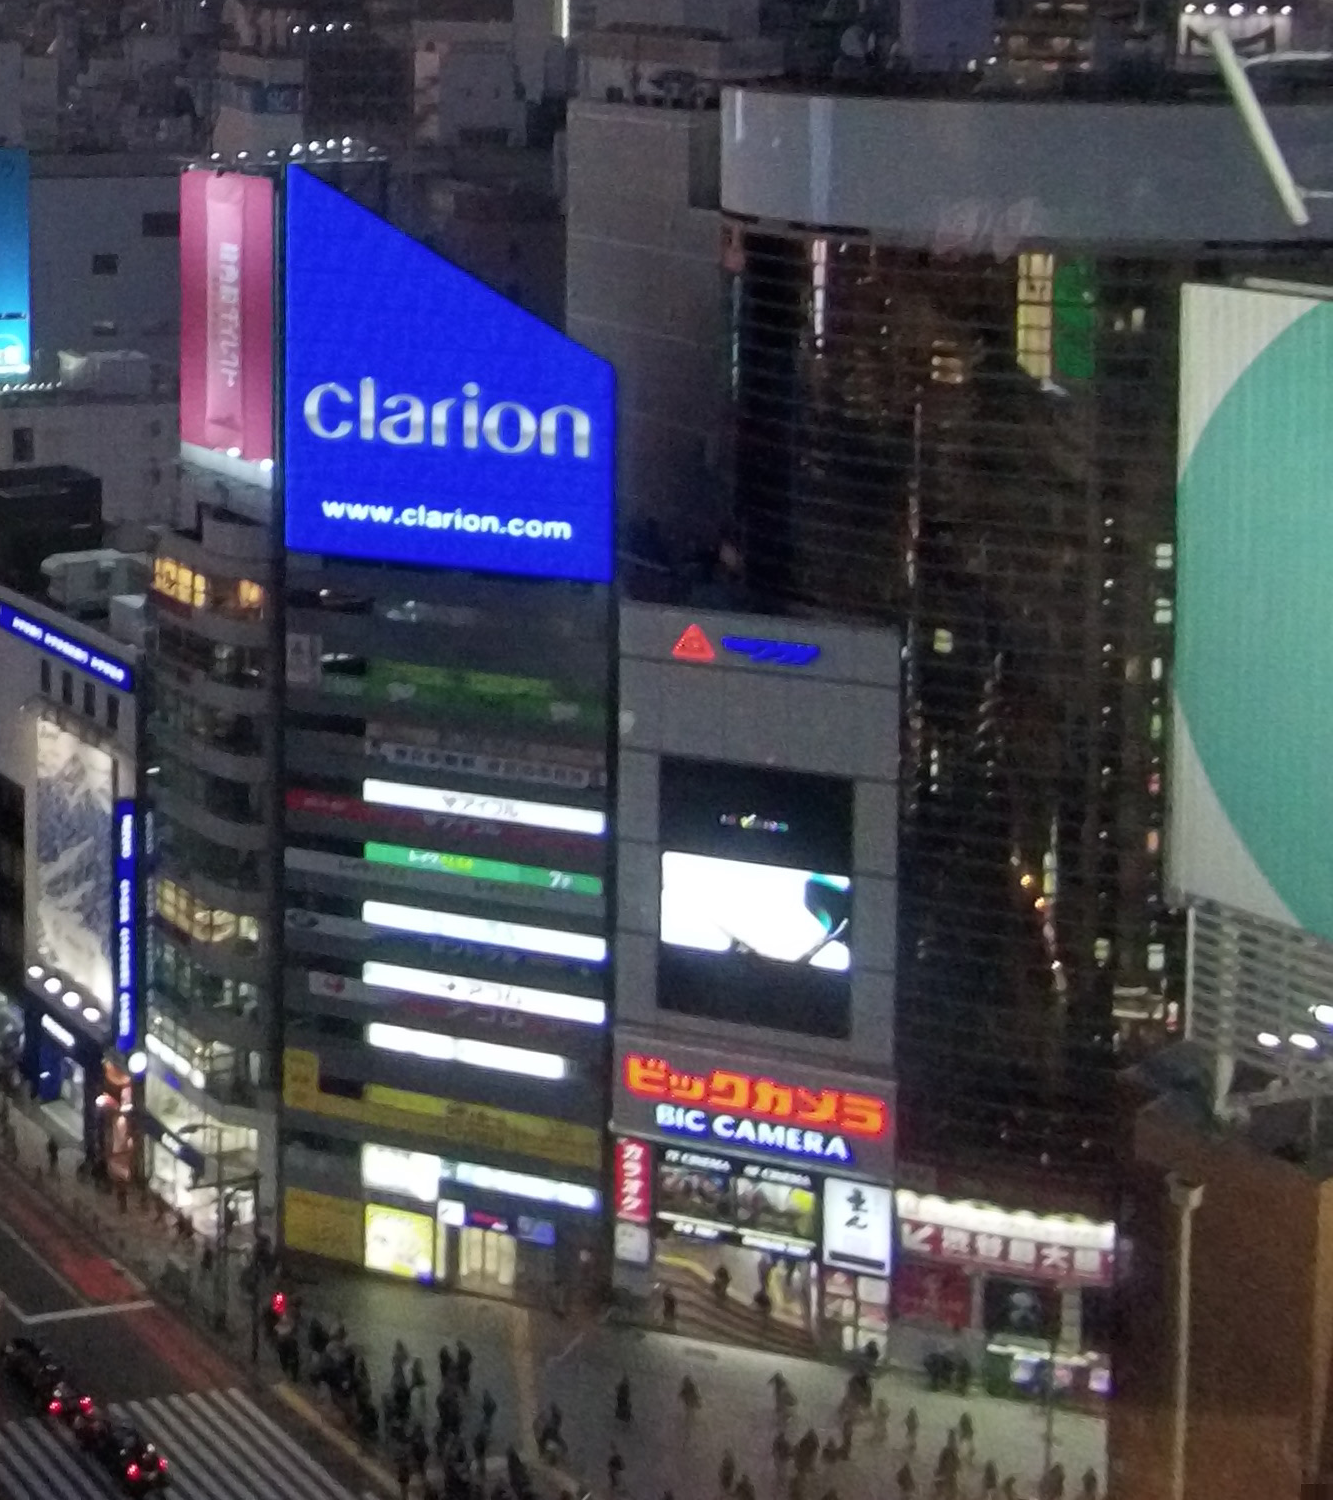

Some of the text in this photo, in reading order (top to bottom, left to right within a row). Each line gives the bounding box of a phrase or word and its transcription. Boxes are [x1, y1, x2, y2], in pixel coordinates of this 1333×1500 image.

[322, 501, 572, 540] www.clarion.com
[626, 1054, 886, 1136] ビックカメラ
[656, 1103, 851, 1160] BIC CAMERA
